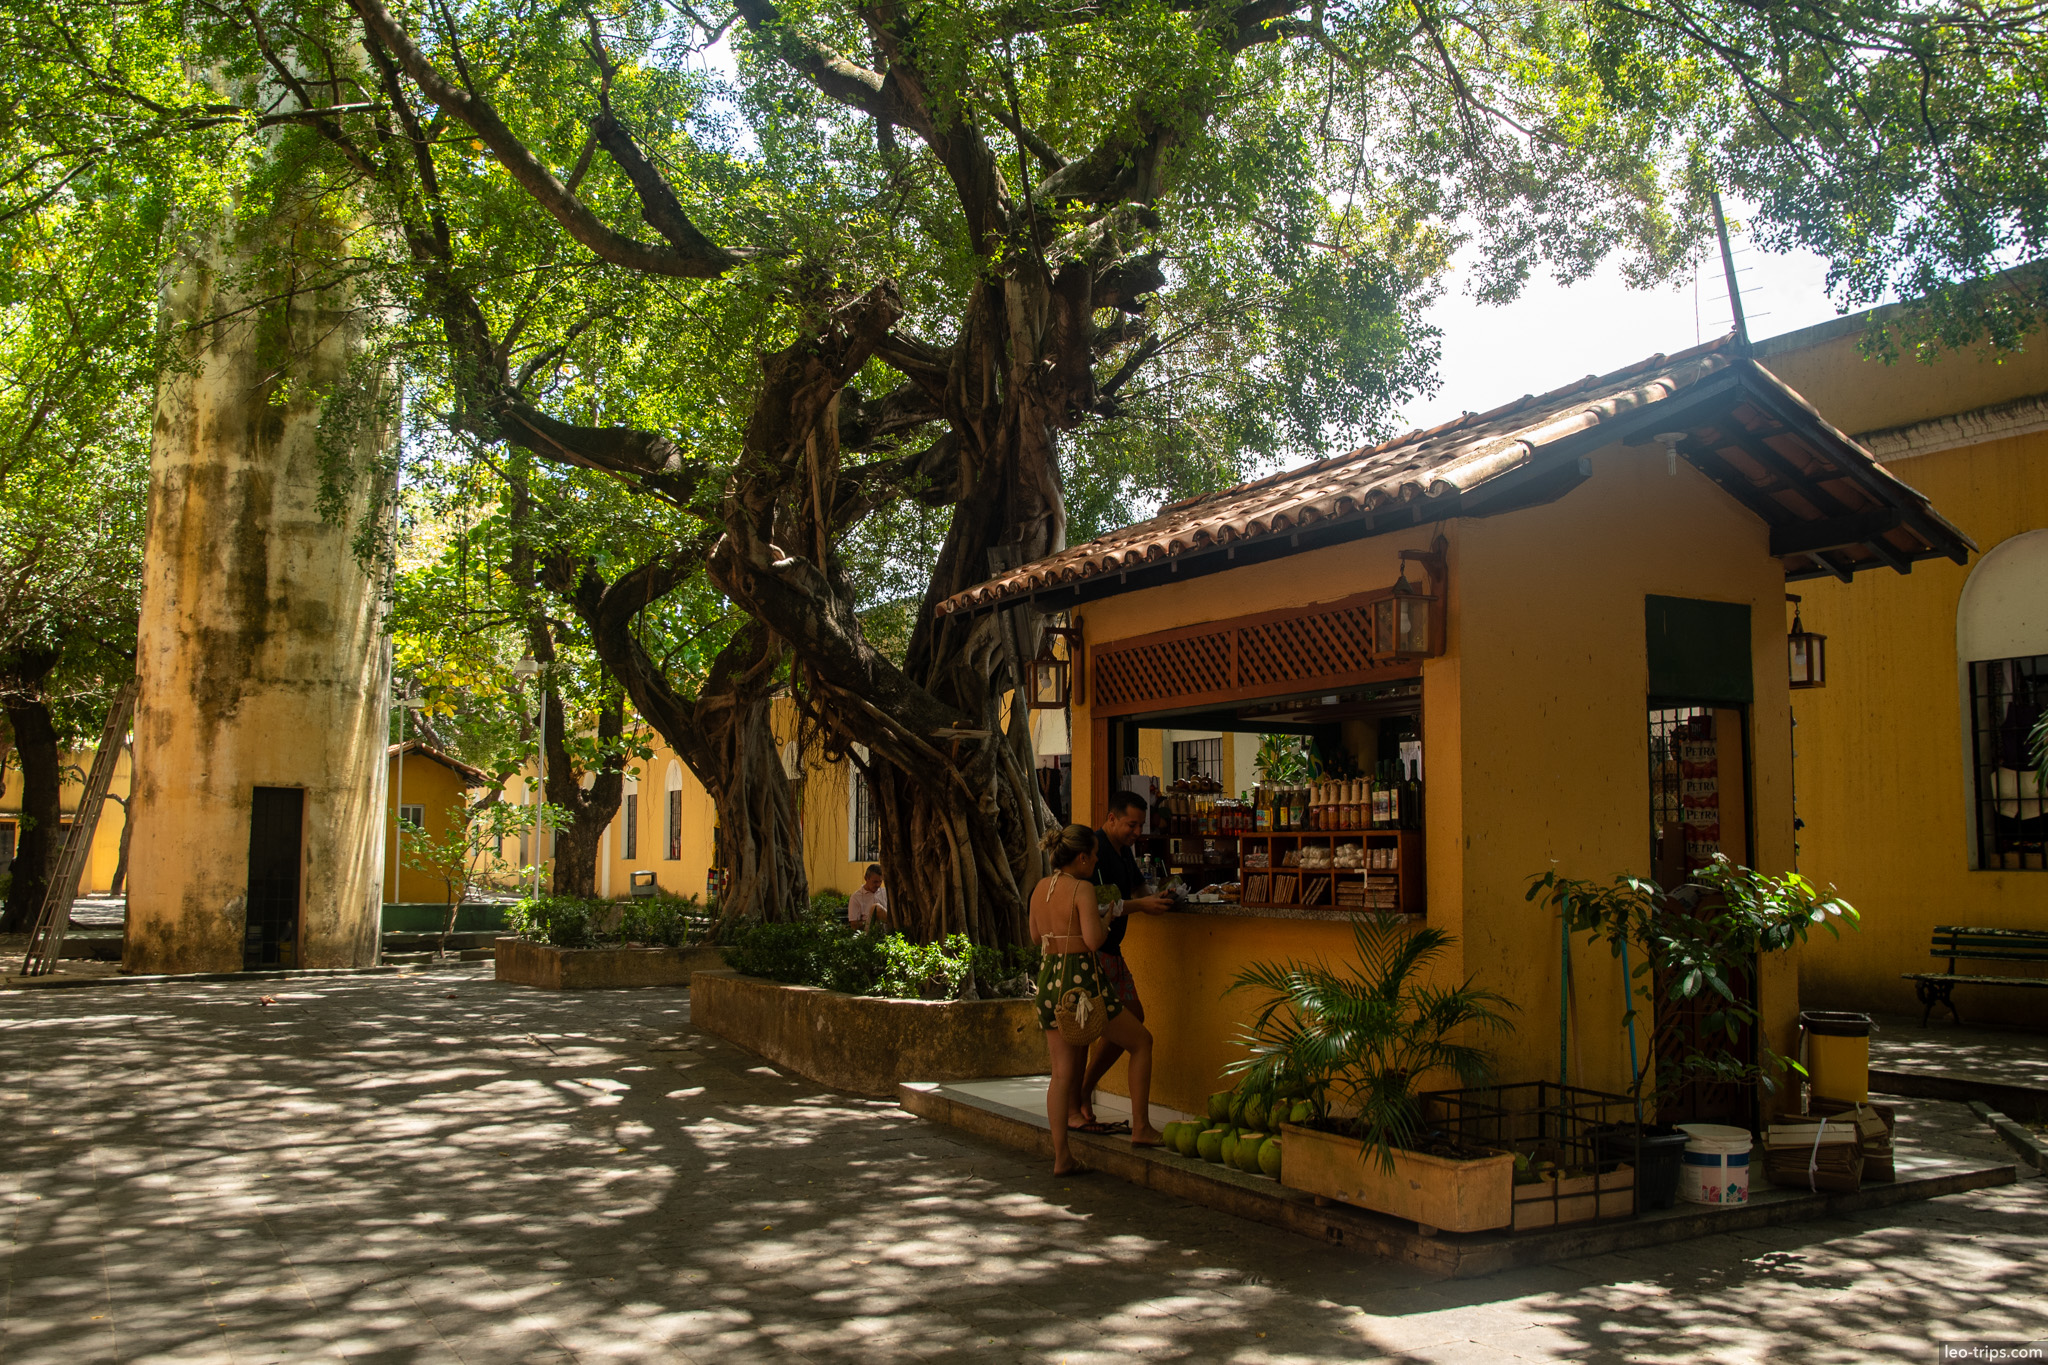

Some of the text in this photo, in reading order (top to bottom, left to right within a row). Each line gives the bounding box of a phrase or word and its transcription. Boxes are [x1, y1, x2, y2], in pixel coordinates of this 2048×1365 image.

[1685, 746, 1716, 757] PETRA
[1687, 781, 1715, 792] PETRA
[1686, 810, 1717, 820] PETRA
[1688, 842, 1719, 853] PETRA
